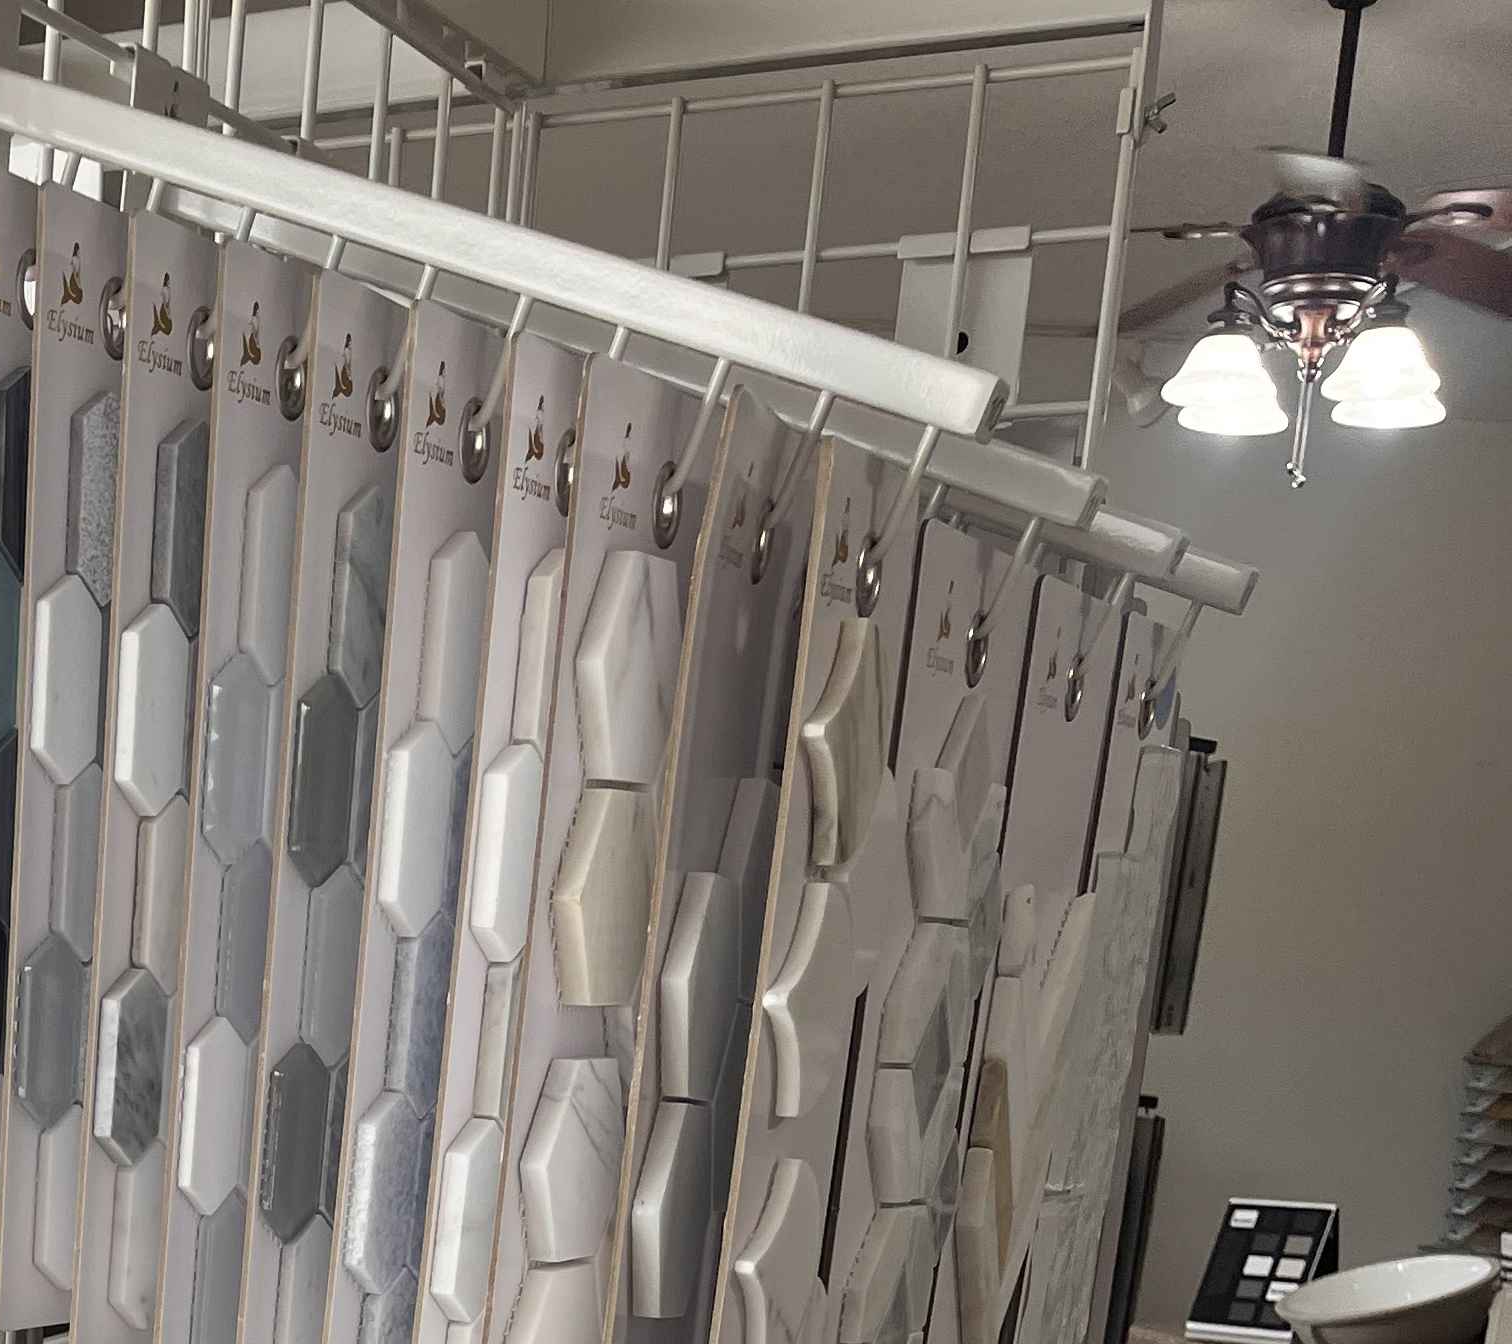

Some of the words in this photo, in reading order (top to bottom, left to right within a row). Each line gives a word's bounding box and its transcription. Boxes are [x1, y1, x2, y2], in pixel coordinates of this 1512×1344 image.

[46, 310, 94, 344] Elysium
[138, 340, 182, 376] Elysium
[227, 370, 271, 405] Elysium
[319, 403, 362, 438] Elysium
[413, 432, 454, 466] Elysium
[513, 467, 551, 500] Elysium
